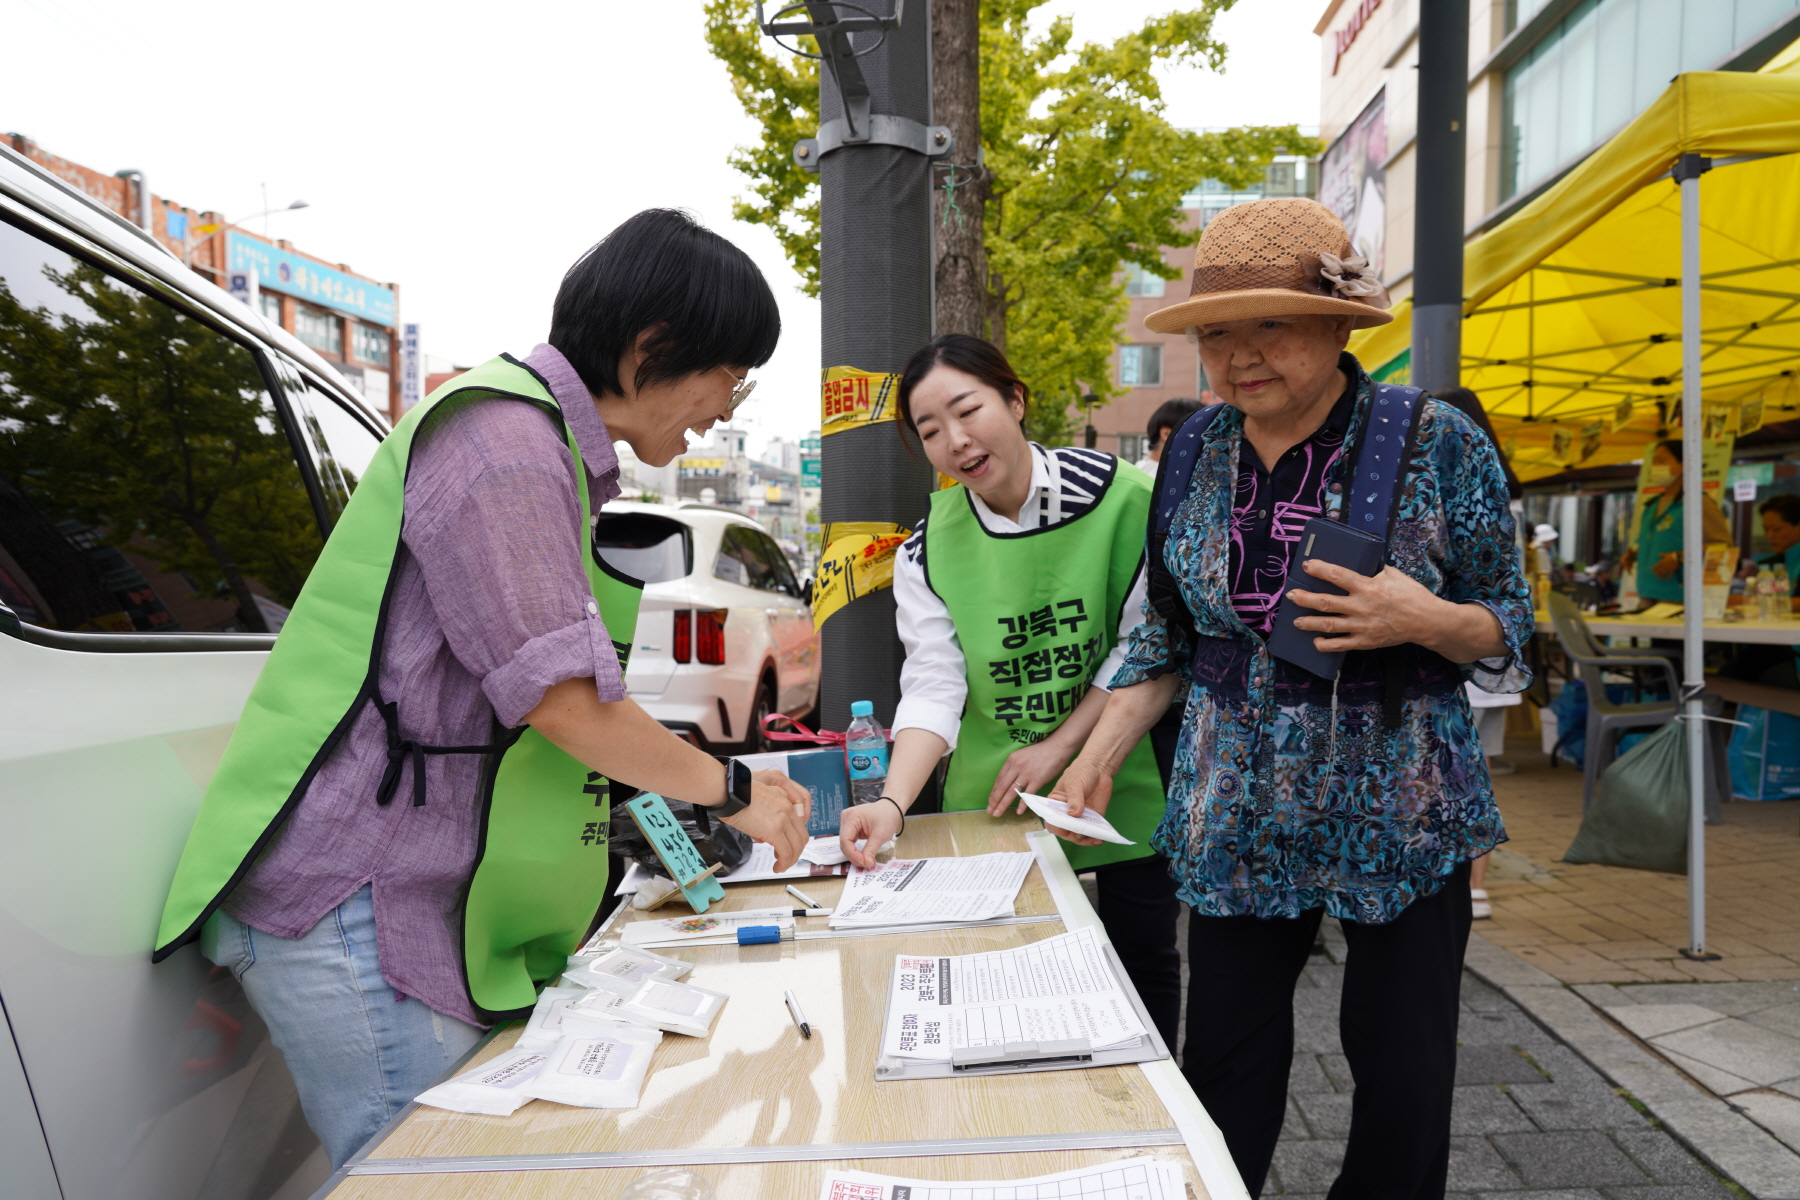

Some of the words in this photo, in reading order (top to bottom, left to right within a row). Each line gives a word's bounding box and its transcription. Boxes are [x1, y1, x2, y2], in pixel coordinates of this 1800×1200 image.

[998, 598, 1088, 649] 강북구
[989, 632, 1104, 688] 직접정치
[1009, 728, 1051, 744] 주민에
[645, 811, 673, 828] 123
[660, 828, 685, 854] 456
[900, 974, 916, 991] 2023
[918, 963, 935, 984] 주민투표
[918, 985, 935, 1002] 강북구
[901, 1013, 918, 1030] 참여자
[899, 1031, 918, 1052] 주민투표
[923, 1021, 941, 1045] 정보작성
